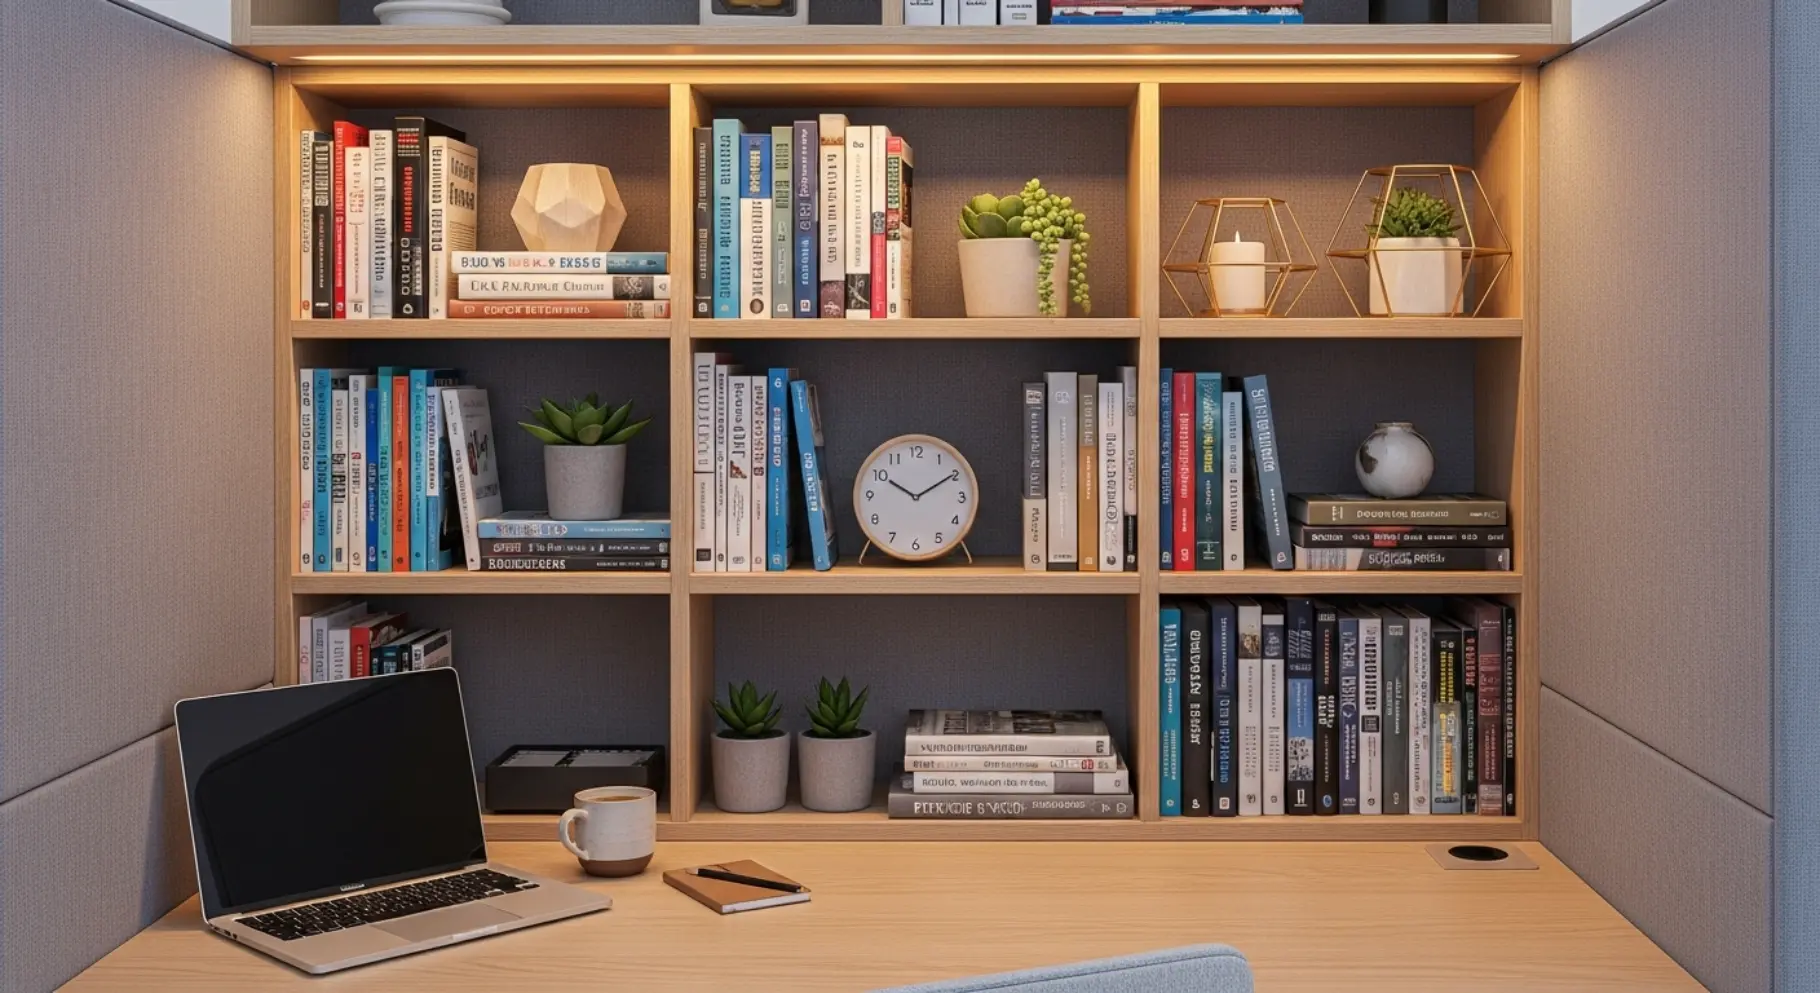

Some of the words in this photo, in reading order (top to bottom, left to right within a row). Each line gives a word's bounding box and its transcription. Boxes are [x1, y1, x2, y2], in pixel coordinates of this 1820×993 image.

[909, 446, 923, 458] 12
[889, 453, 900, 465] 11
[937, 454, 941, 465] 1
[873, 469, 888, 481] 10
[951, 469, 960, 481] 2
[865, 490, 875, 502] 9
[958, 491, 967, 504] 3
[871, 513, 879, 525] 8
[951, 515, 959, 525] 4
[888, 532, 897, 544] 7
[935, 532, 943, 543] 5
[912, 538, 920, 551] 6
